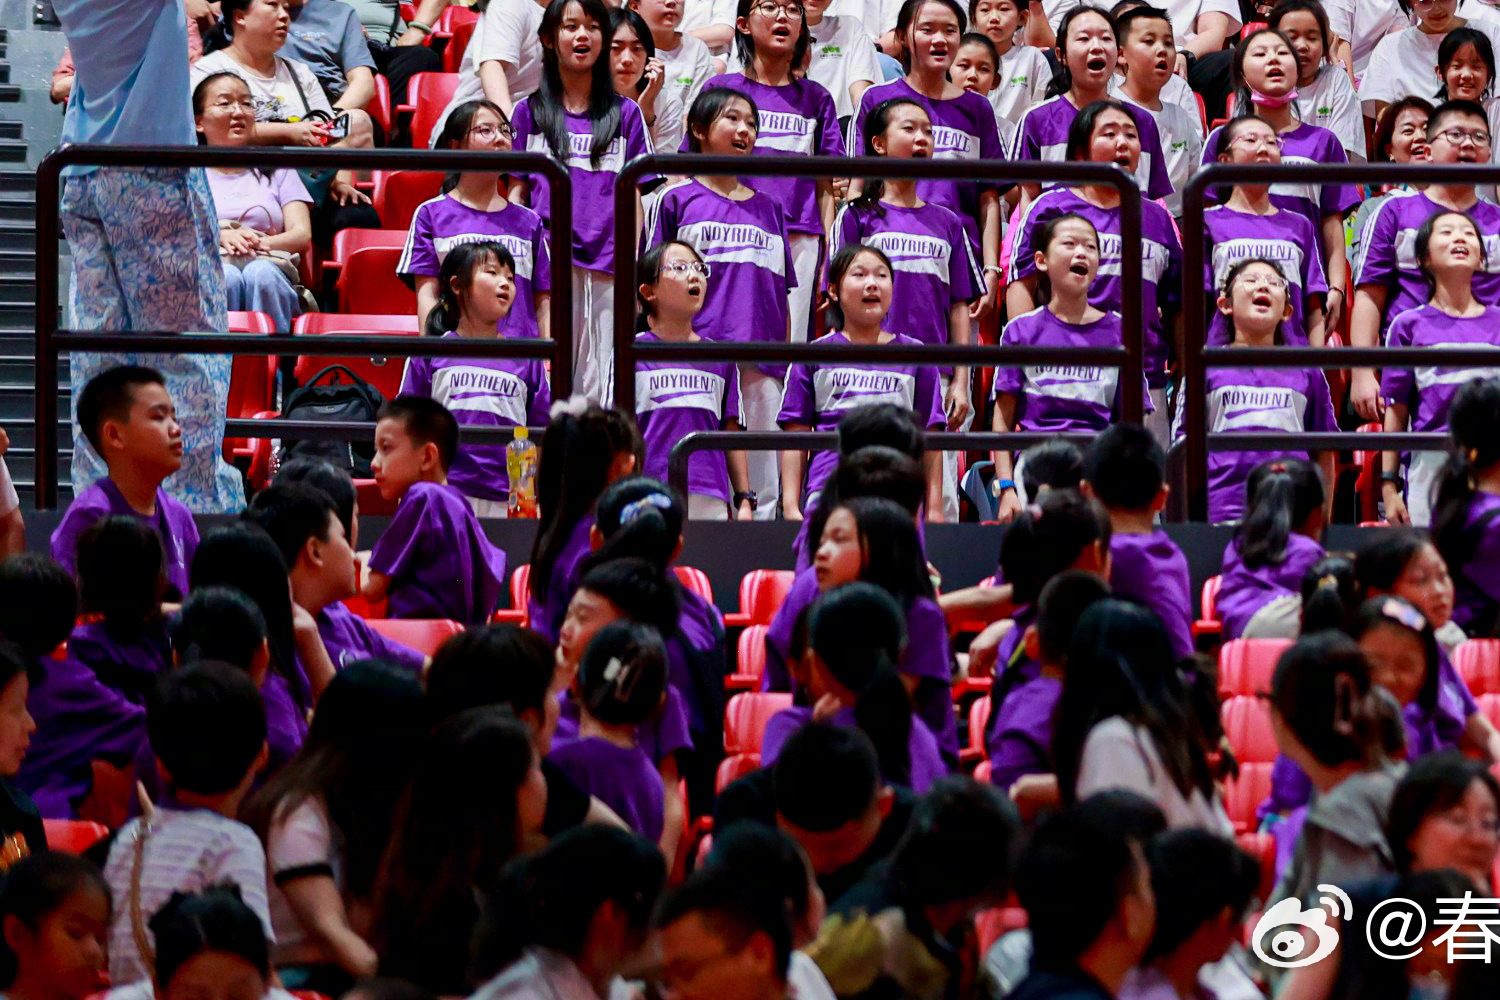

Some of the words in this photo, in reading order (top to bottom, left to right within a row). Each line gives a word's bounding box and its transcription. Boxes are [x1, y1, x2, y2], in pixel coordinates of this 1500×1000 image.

[760, 112, 811, 135] YRIENT
[701, 224, 773, 249] NOYRIENT
[881, 237, 945, 258] NOYRIENT
[450, 373, 519, 397] NOYRIENT
[650, 374, 716, 393] NOYRIENT
[832, 372, 901, 393] NOYRIENT
[1222, 391, 1291, 408] NOYRIENT
